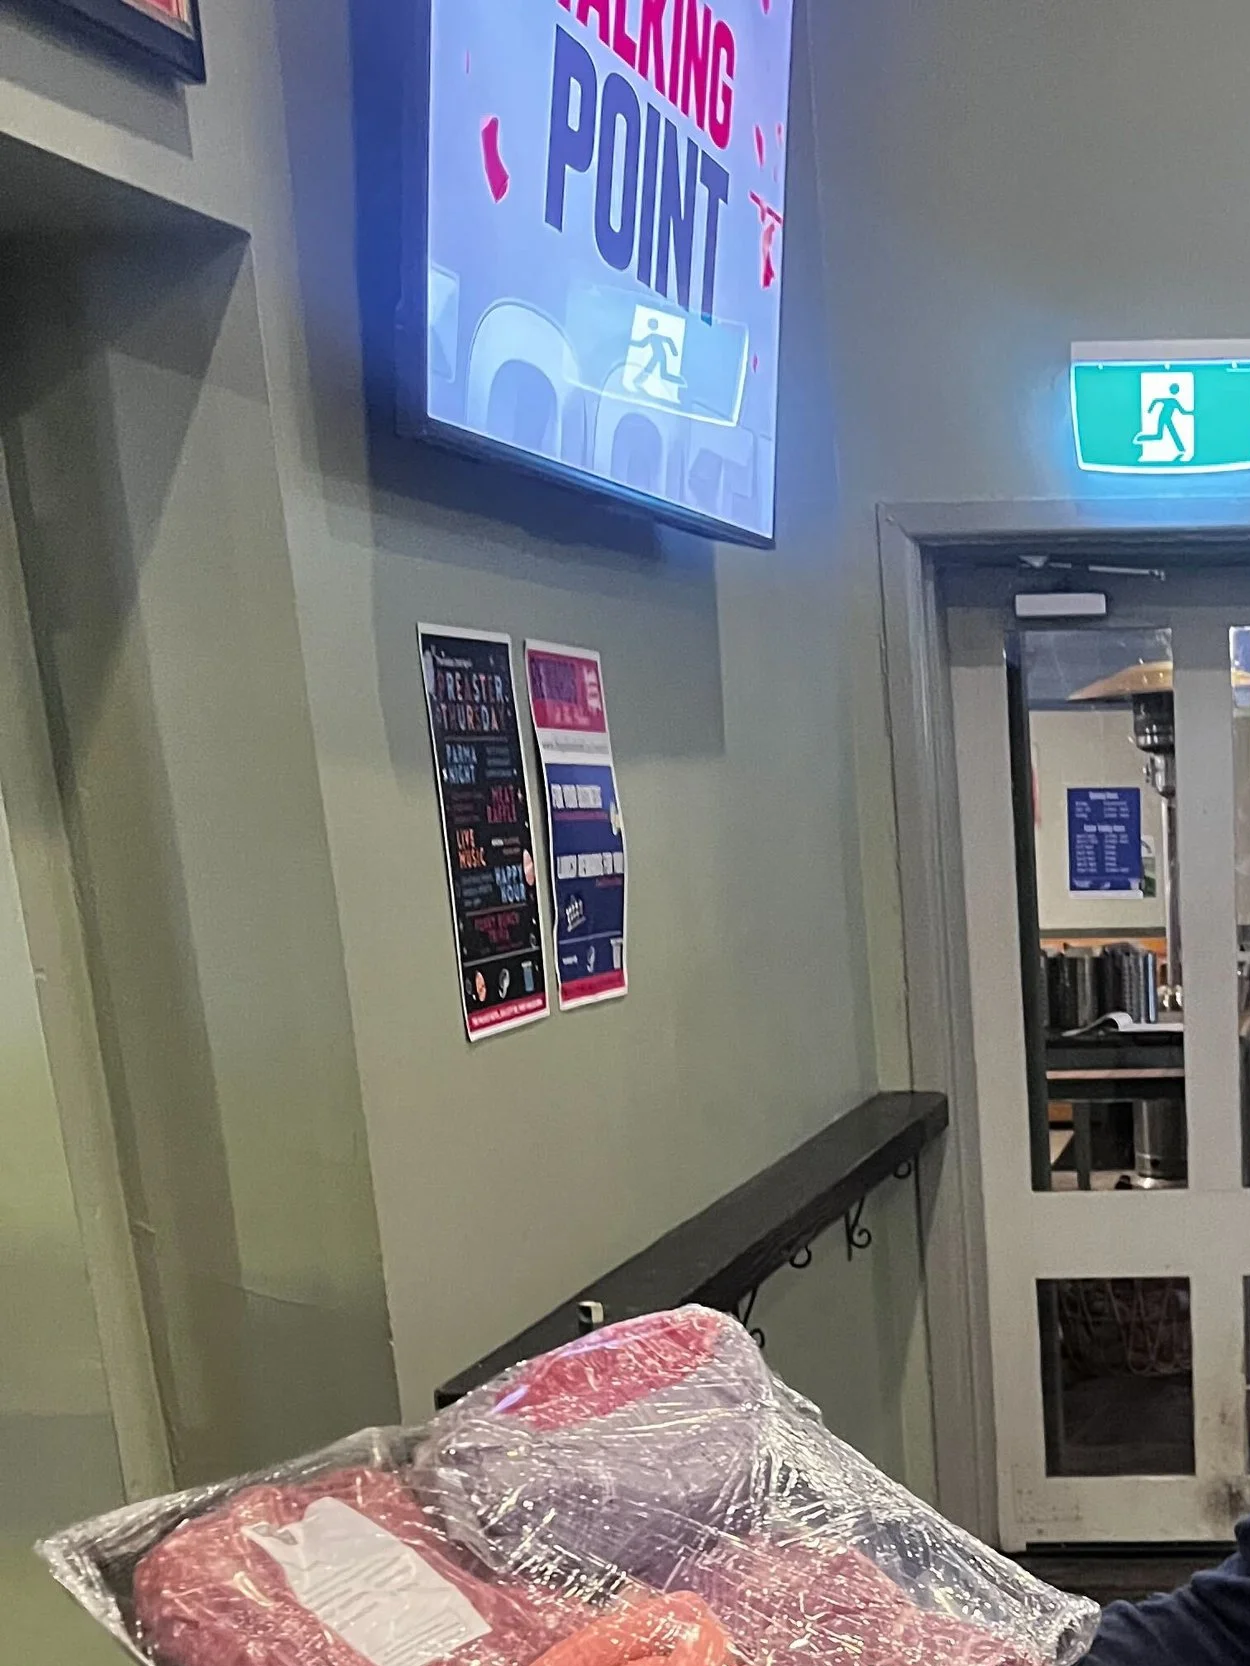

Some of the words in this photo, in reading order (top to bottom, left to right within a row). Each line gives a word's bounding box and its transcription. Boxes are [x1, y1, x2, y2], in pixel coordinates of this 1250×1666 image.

[556, 0, 735, 149] KING
[544, 24, 730, 327] POINT
[456, 828, 475, 849] LIVE
[457, 846, 487, 869] MUSIC
[494, 865, 523, 886] HAPPY
[499, 883, 527, 903] HOUR
